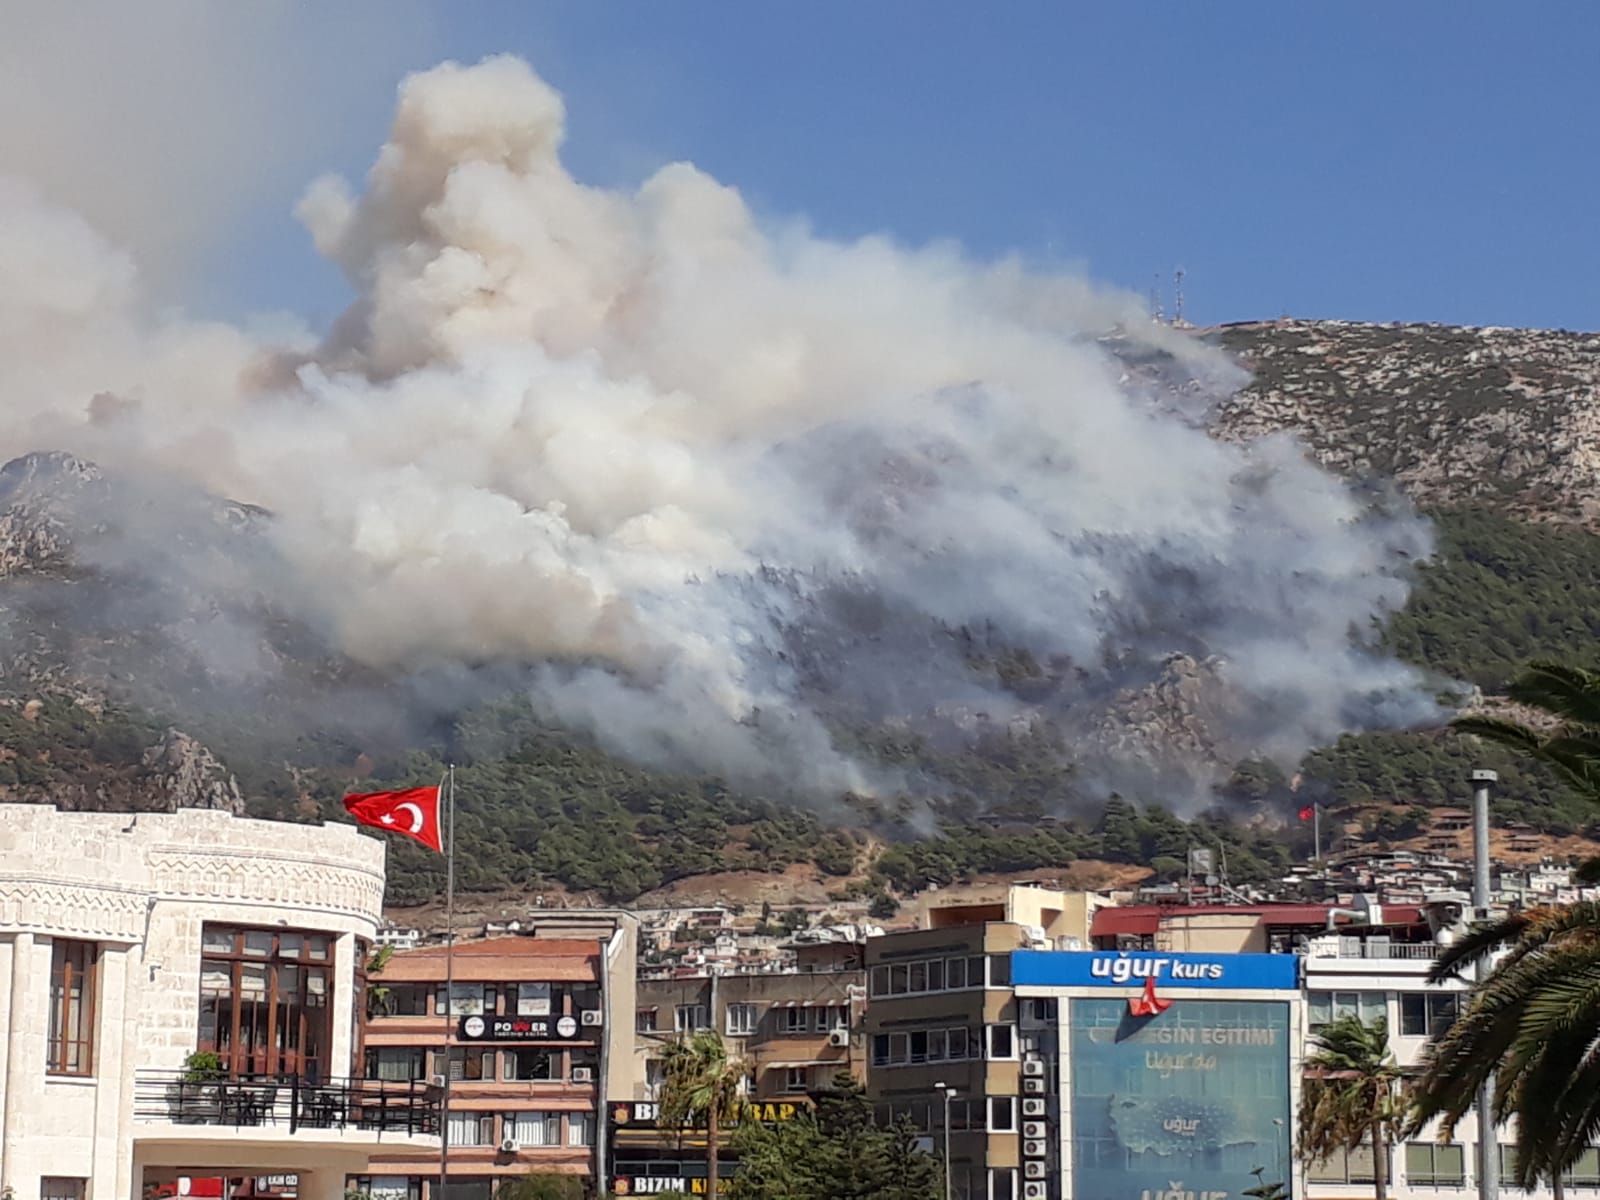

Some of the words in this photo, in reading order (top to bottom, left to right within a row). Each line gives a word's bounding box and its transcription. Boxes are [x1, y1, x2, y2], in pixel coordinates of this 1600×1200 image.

[1091, 952, 1169, 983] uğur
[1171, 960, 1224, 978] kurs
[494, 1021, 548, 1032] POWER
